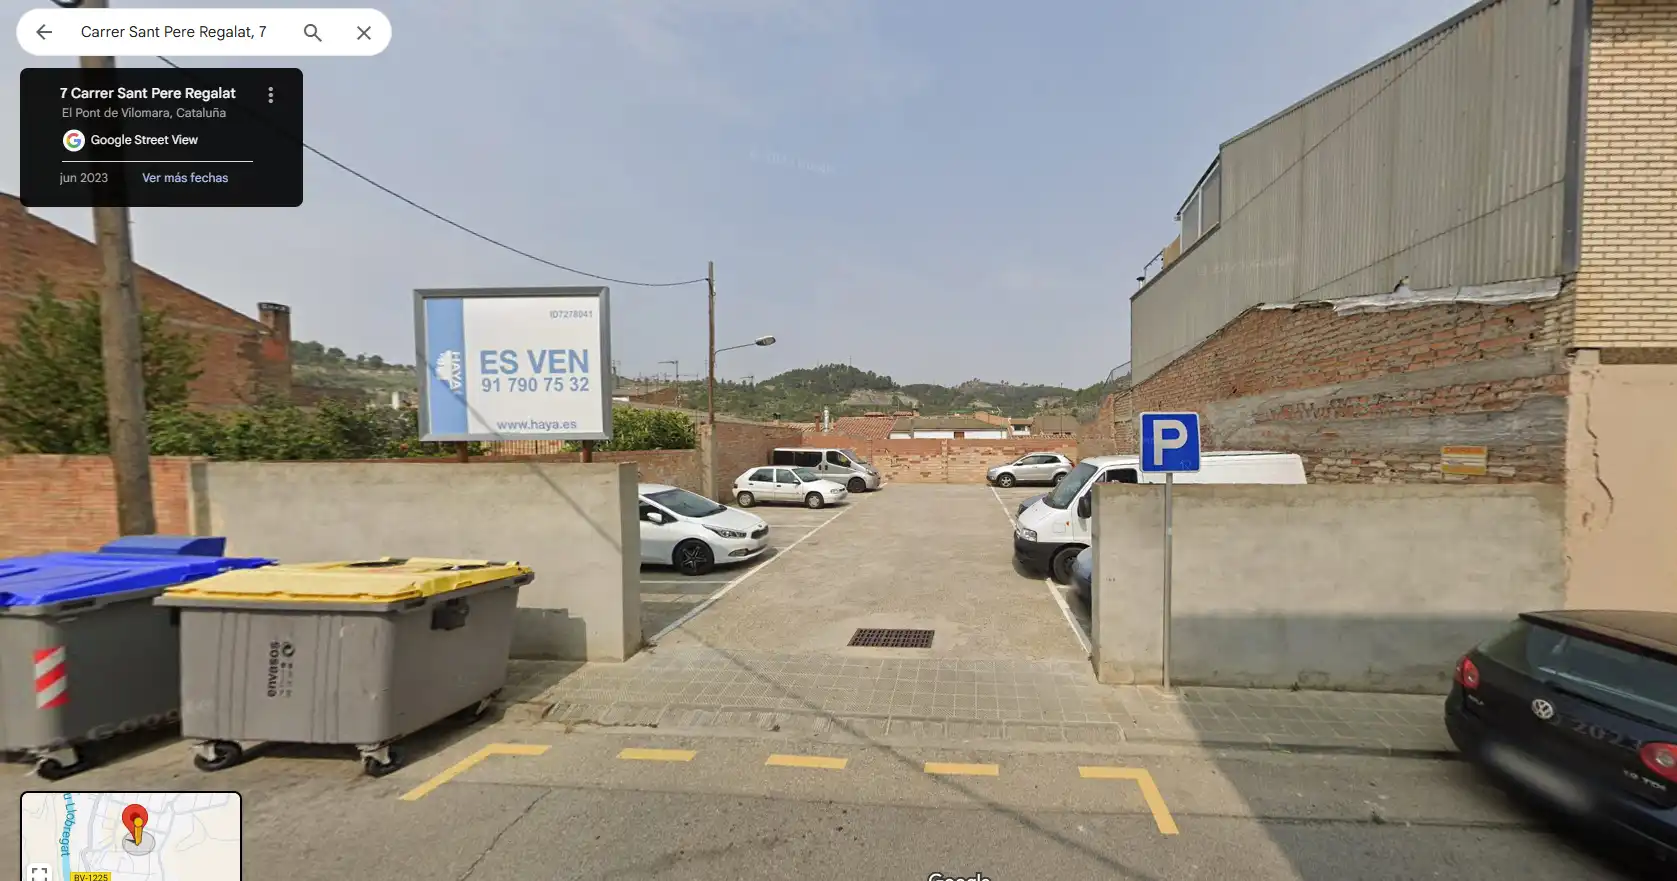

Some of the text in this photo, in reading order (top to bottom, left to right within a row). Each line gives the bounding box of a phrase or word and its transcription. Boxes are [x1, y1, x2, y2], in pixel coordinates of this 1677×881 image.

[452, 351, 462, 392] HAYA
[479, 349, 588, 375] ES VEN
[482, 376, 589, 392] 91 790 75 32
[496, 419, 577, 433] www.haya.es
[1153, 420, 1188, 466] P
